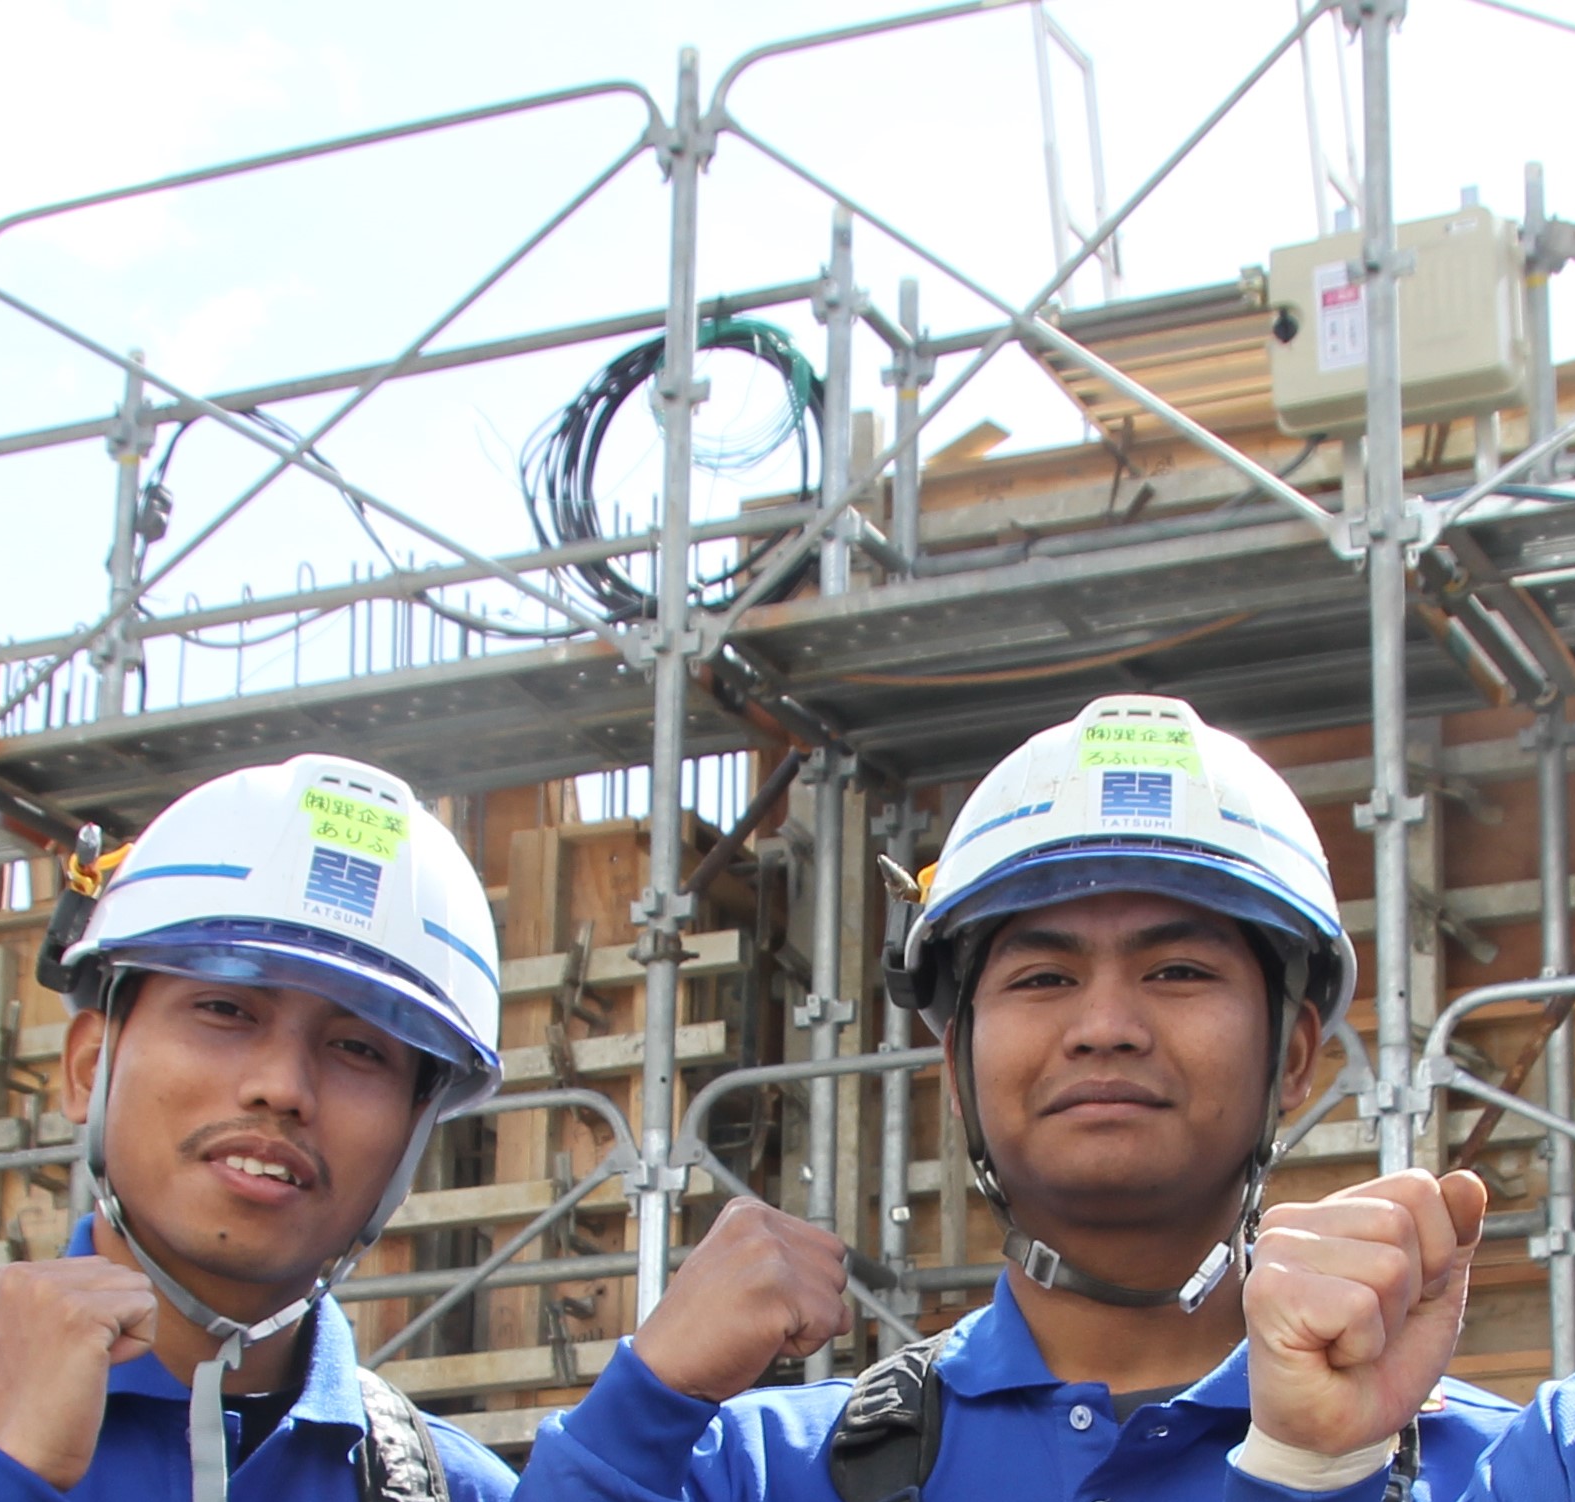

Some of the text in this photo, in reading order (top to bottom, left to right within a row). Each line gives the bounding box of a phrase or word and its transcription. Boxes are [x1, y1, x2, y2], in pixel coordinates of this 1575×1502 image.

[316, 820, 390, 854] ありふ
[1101, 818, 1173, 829] TATSUMI
[301, 901, 373, 931] TATSUMI
